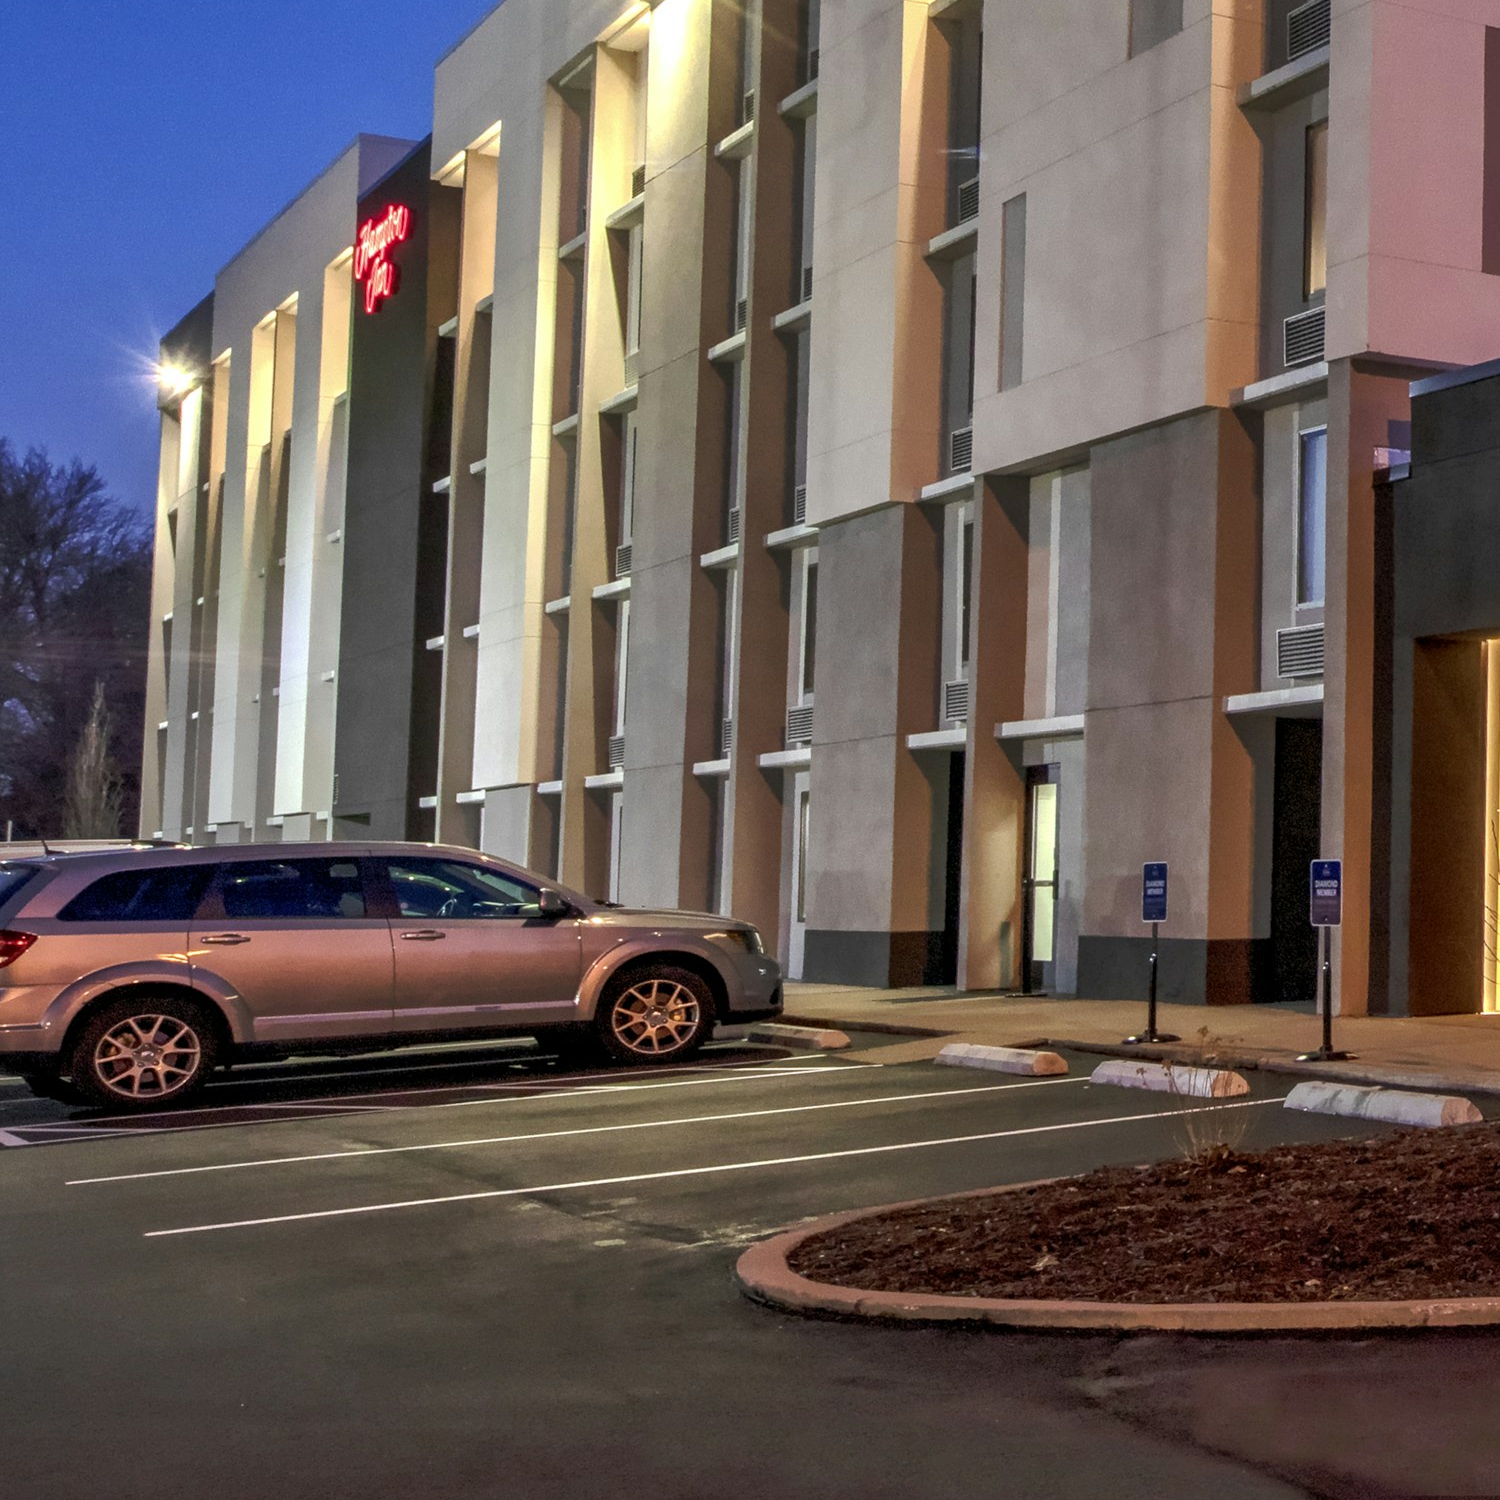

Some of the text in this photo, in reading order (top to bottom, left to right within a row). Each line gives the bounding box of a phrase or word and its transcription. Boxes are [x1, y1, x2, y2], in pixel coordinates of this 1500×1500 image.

[354, 204, 409, 279] Hampton
[365, 256, 394, 313] Inn
[1314, 880, 1338, 888] DIAMOND
[1316, 888, 1337, 897] MEMBER
